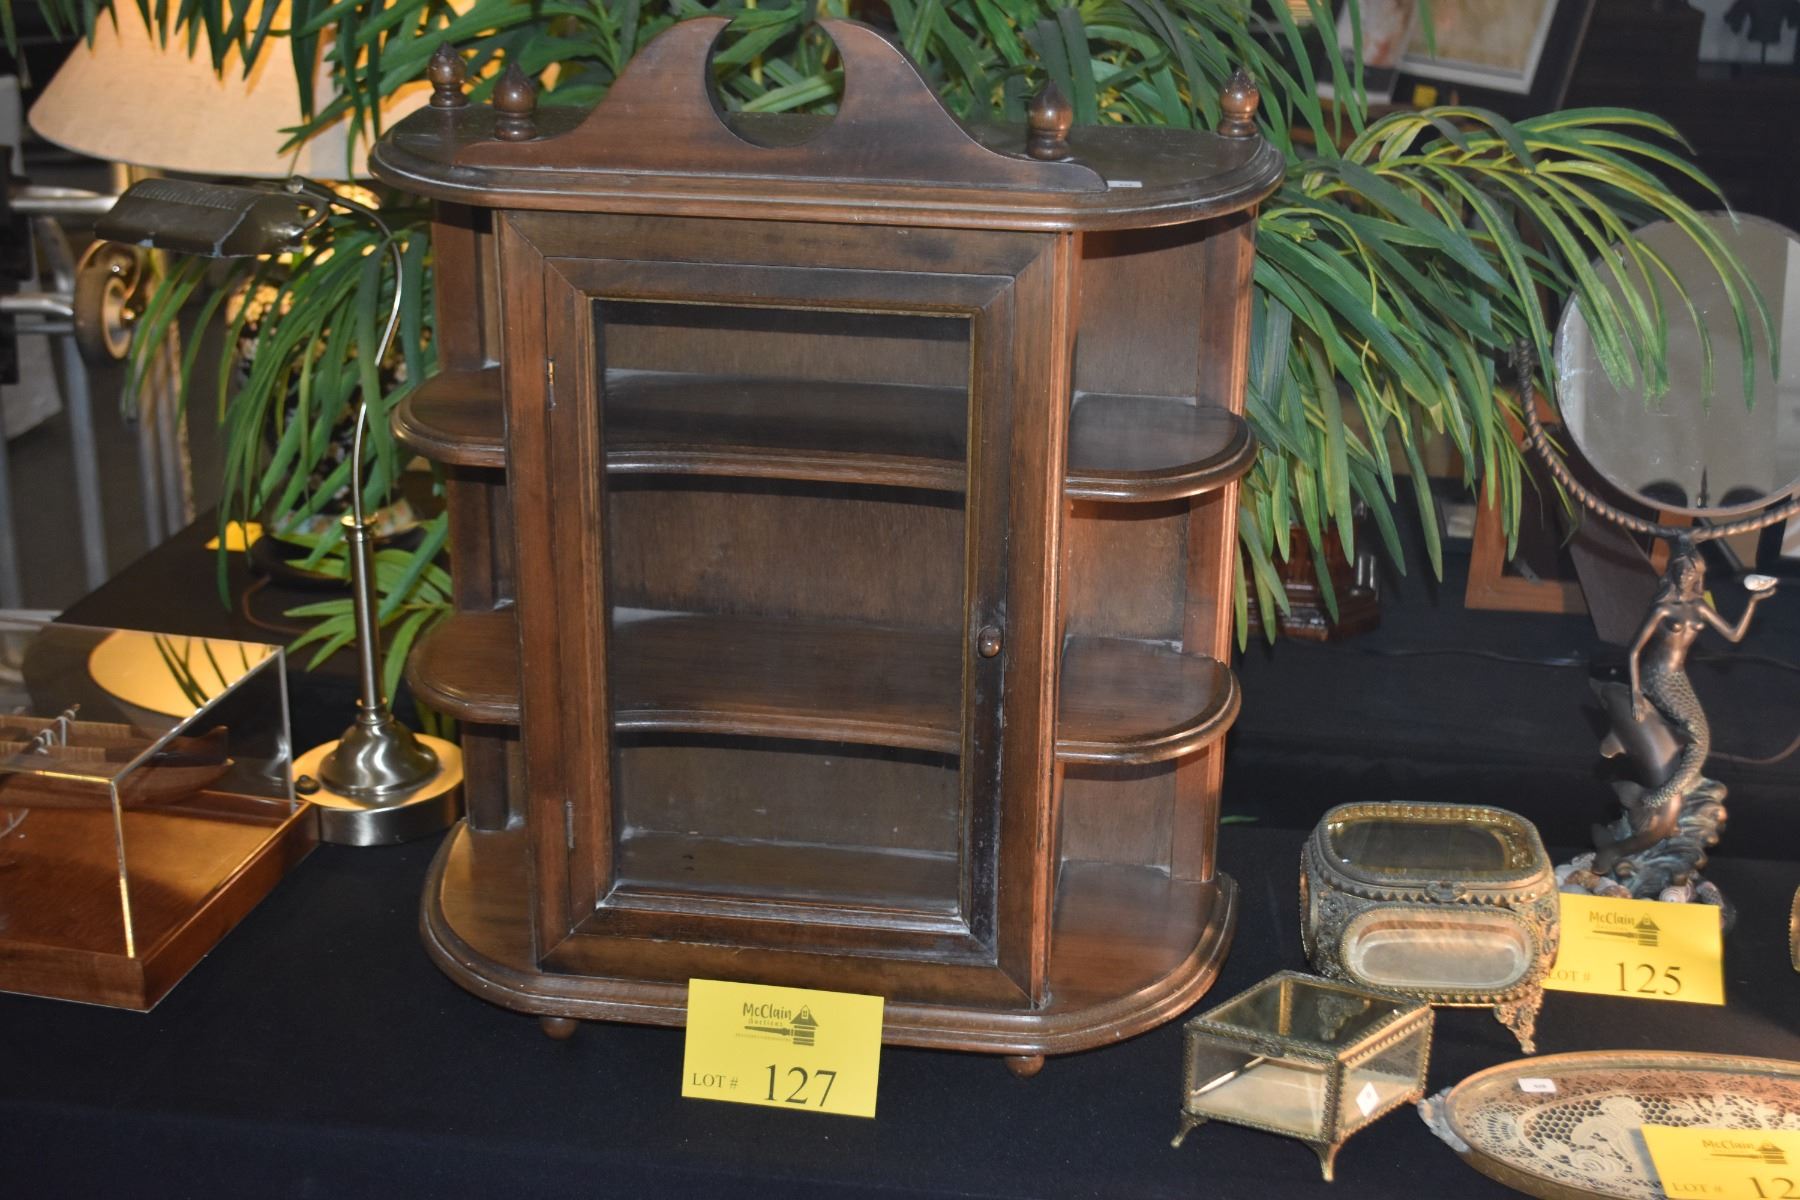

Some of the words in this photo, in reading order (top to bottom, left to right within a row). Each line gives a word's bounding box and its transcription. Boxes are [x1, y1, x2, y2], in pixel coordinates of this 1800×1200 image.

[1589, 911, 1635, 926] McClain
[1548, 969, 1578, 981] LOT
[1616, 961, 1682, 996] 125
[742, 1002, 792, 1020] McClain
[692, 1073, 726, 1088] LOT
[730, 1078, 738, 1090] #
[765, 1064, 837, 1107] 127
[1702, 1139, 1755, 1150] McClain
[1672, 1183, 1708, 1193] LOT
